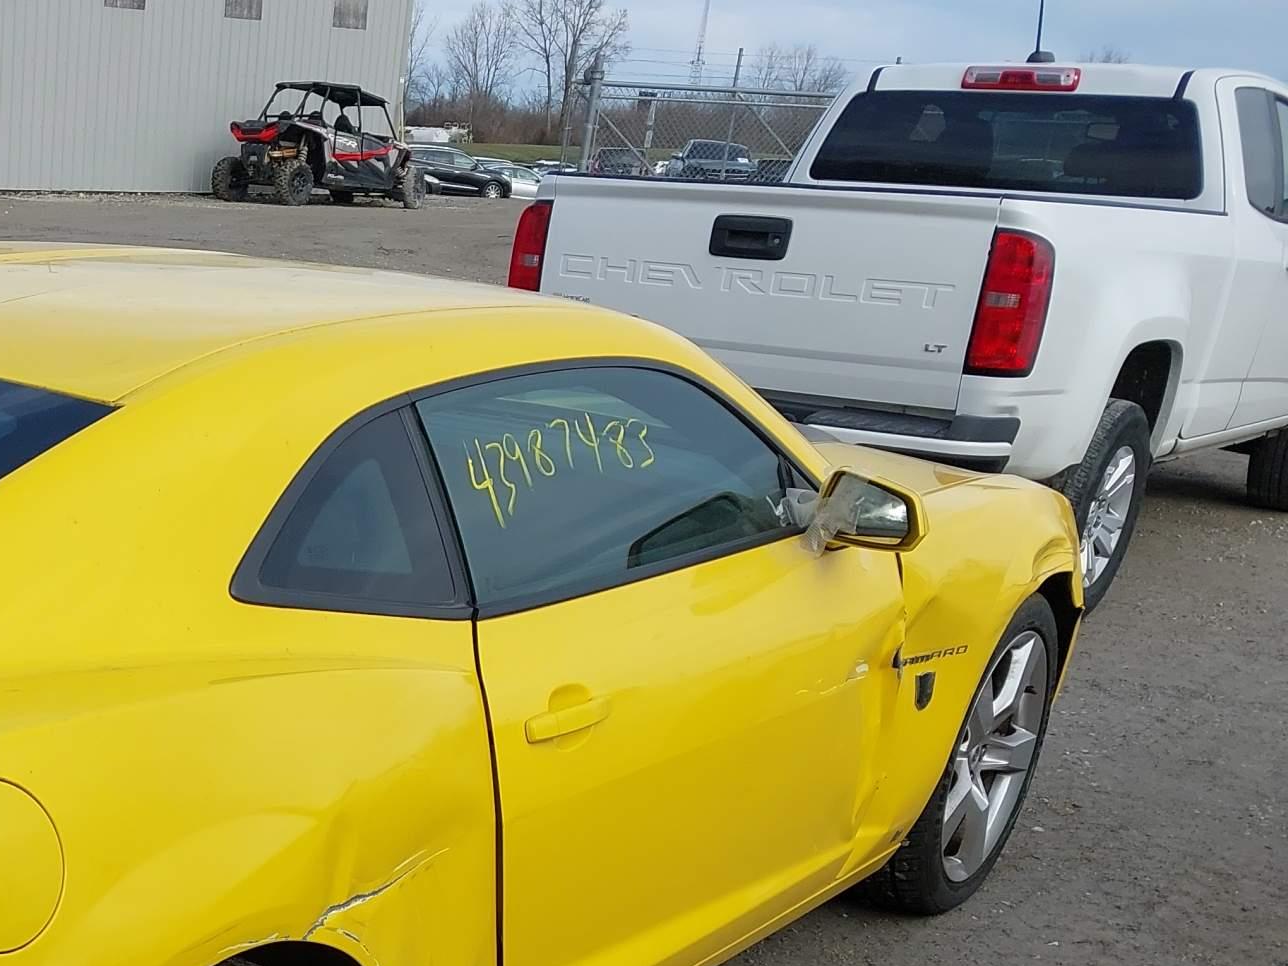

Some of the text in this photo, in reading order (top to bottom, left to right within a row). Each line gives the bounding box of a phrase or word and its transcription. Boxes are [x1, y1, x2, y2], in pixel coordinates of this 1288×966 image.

[559, 252, 955, 310] CHEVROLET
[924, 343, 948, 354] LT
[463, 412, 655, 529] 43987483
[901, 644, 969, 667] AMARO
